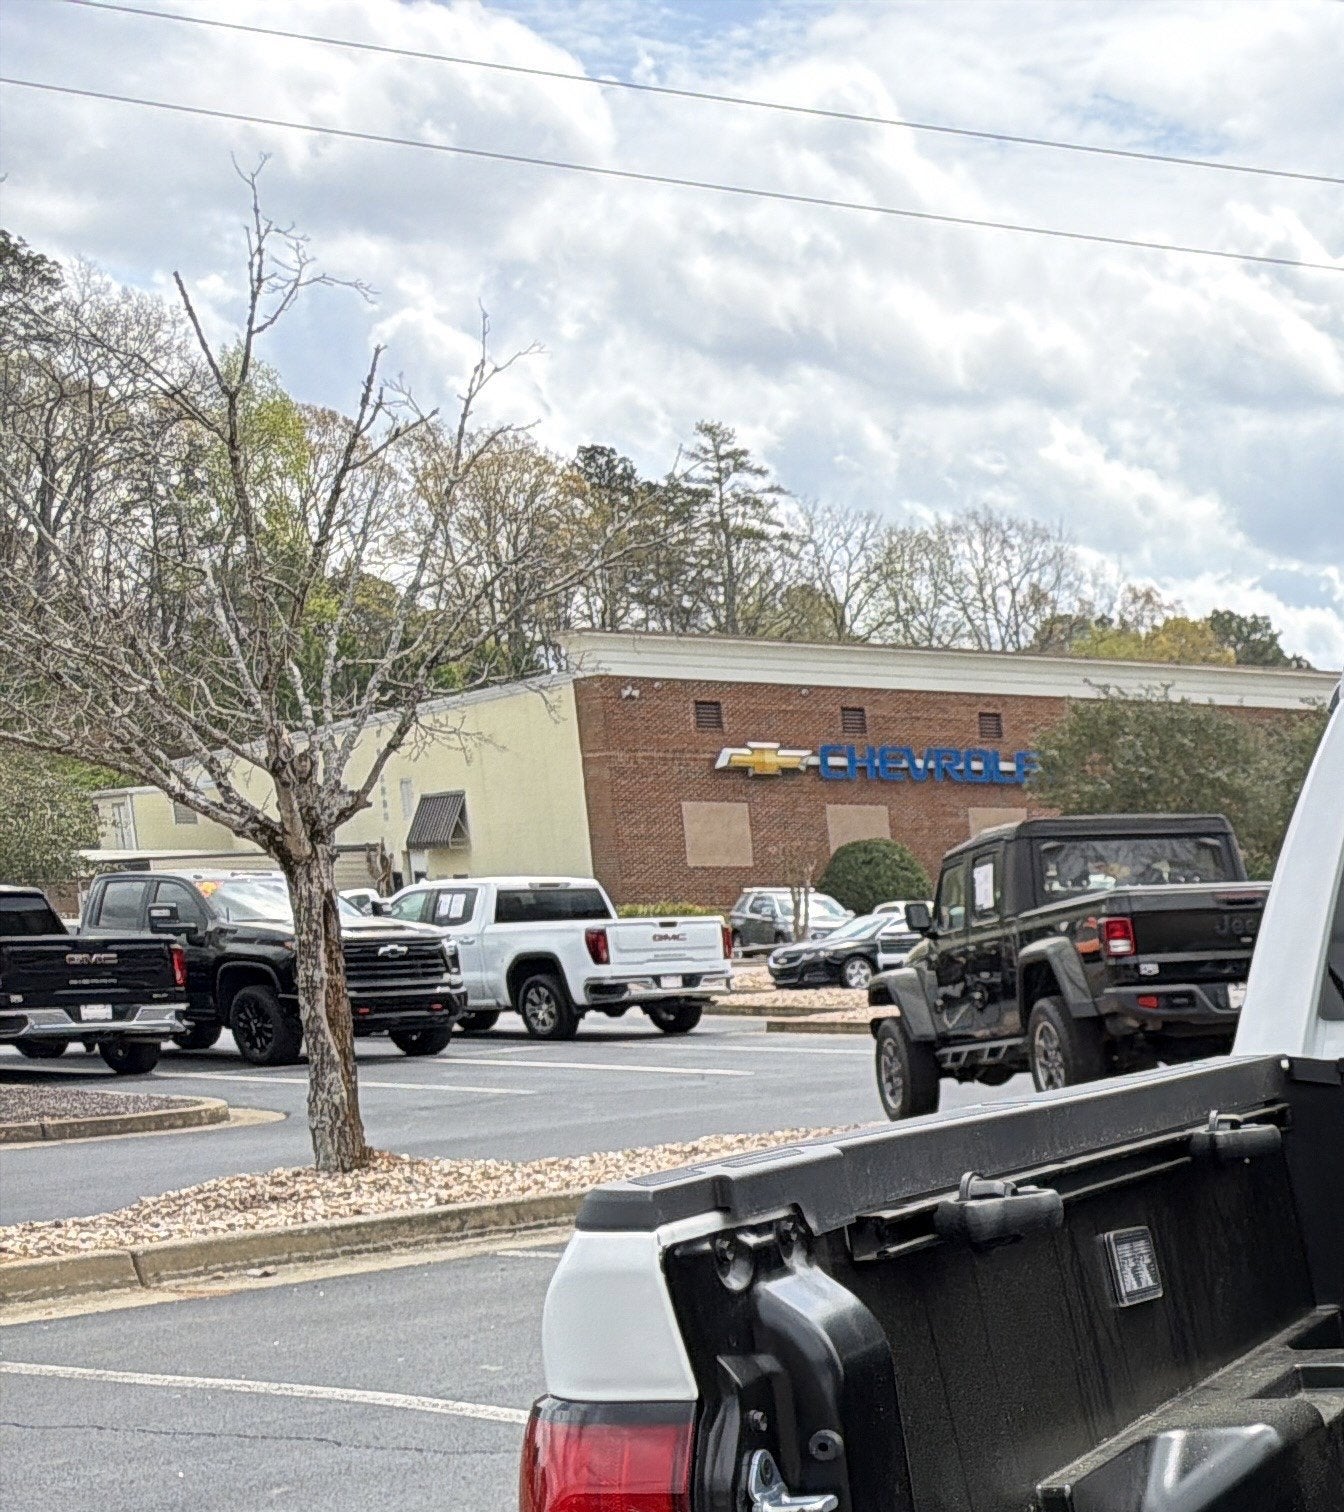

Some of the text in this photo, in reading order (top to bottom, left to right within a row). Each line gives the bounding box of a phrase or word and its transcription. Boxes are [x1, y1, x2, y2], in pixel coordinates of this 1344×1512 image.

[819, 744, 1042, 784] CHEVROLE
[1214, 913, 1258, 936] Jee
[652, 932, 688, 942] GMC
[65, 953, 119, 965] GMC
